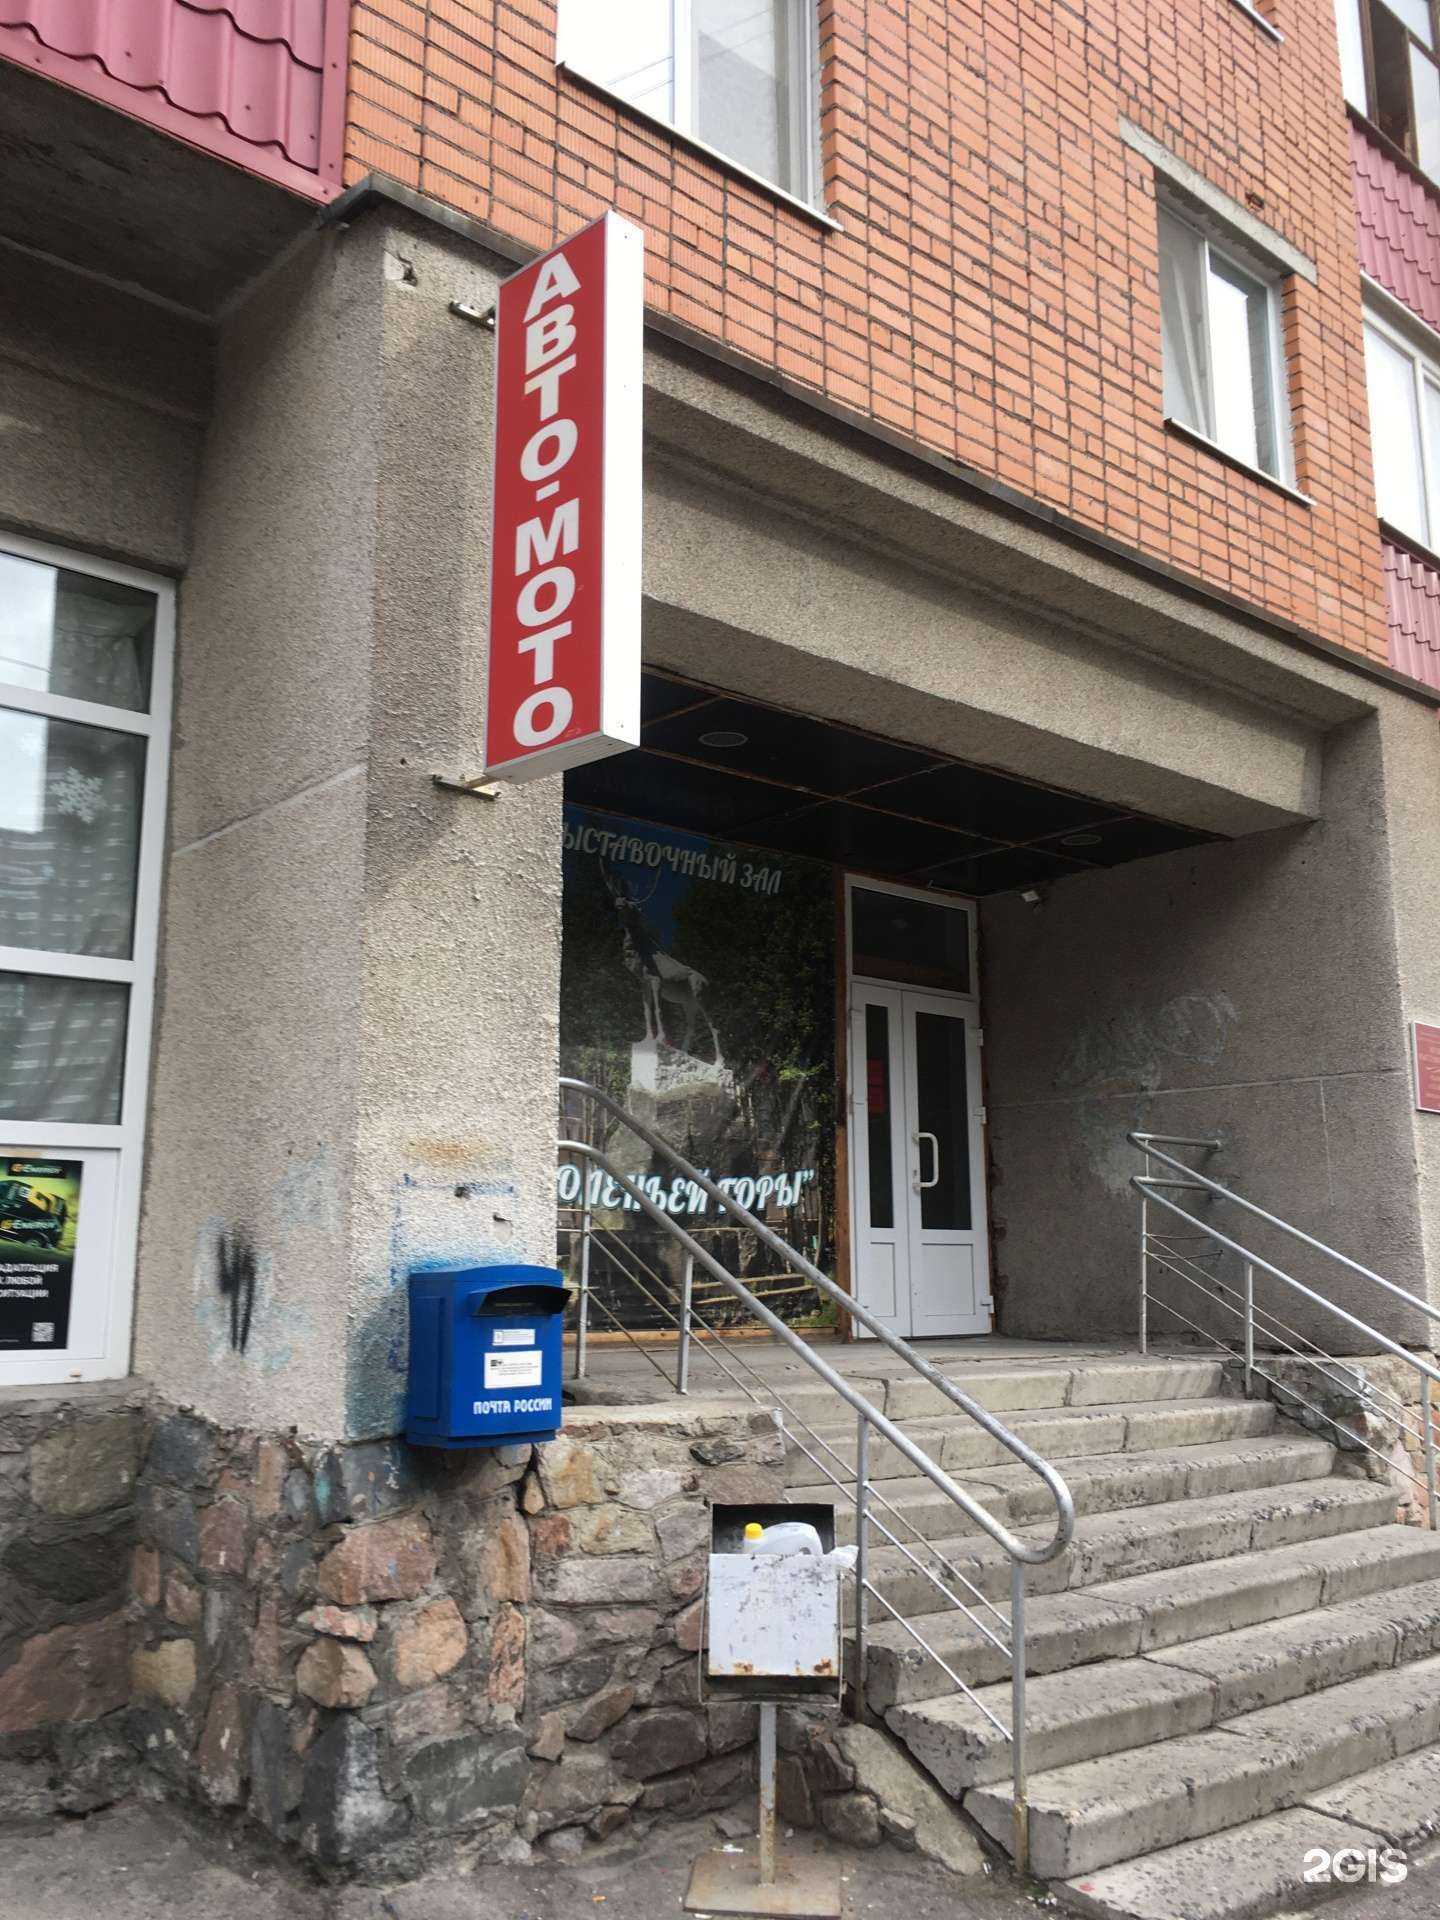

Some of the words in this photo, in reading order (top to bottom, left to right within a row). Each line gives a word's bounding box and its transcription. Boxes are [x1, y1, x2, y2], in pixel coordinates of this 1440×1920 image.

[512, 252, 581, 747] АВТО-МОТО
[740, 863, 783, 896] ЗАЛ
[473, 1400, 511, 1415] ПОЧТА
[513, 1397, 553, 1413] РОССИИ
